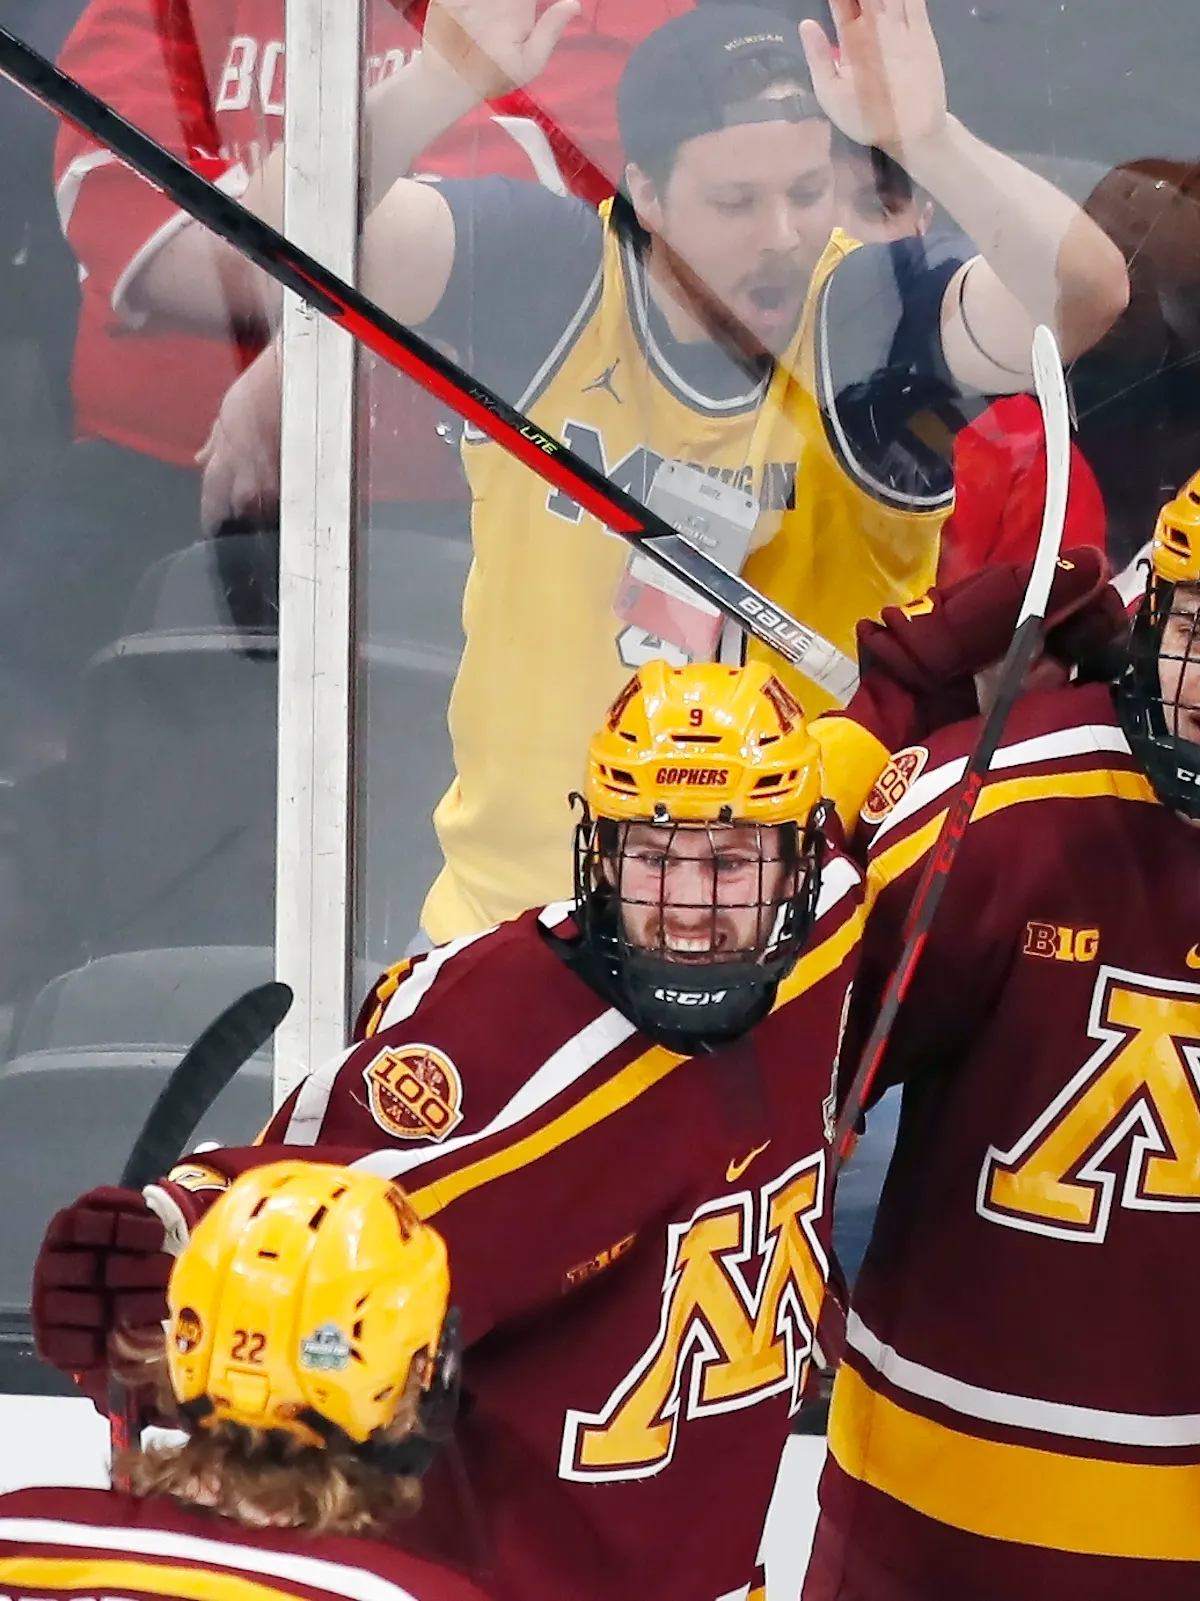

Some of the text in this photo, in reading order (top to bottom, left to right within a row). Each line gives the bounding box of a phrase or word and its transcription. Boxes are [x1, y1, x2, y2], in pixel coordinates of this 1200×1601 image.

[689, 707, 704, 728] 9
[656, 766, 729, 786] GOPHERS
[653, 988, 728, 1006] CCM
[373, 1055, 450, 1131] 100
[558, 1148, 830, 1483] M
[231, 1329, 267, 1364] 22
